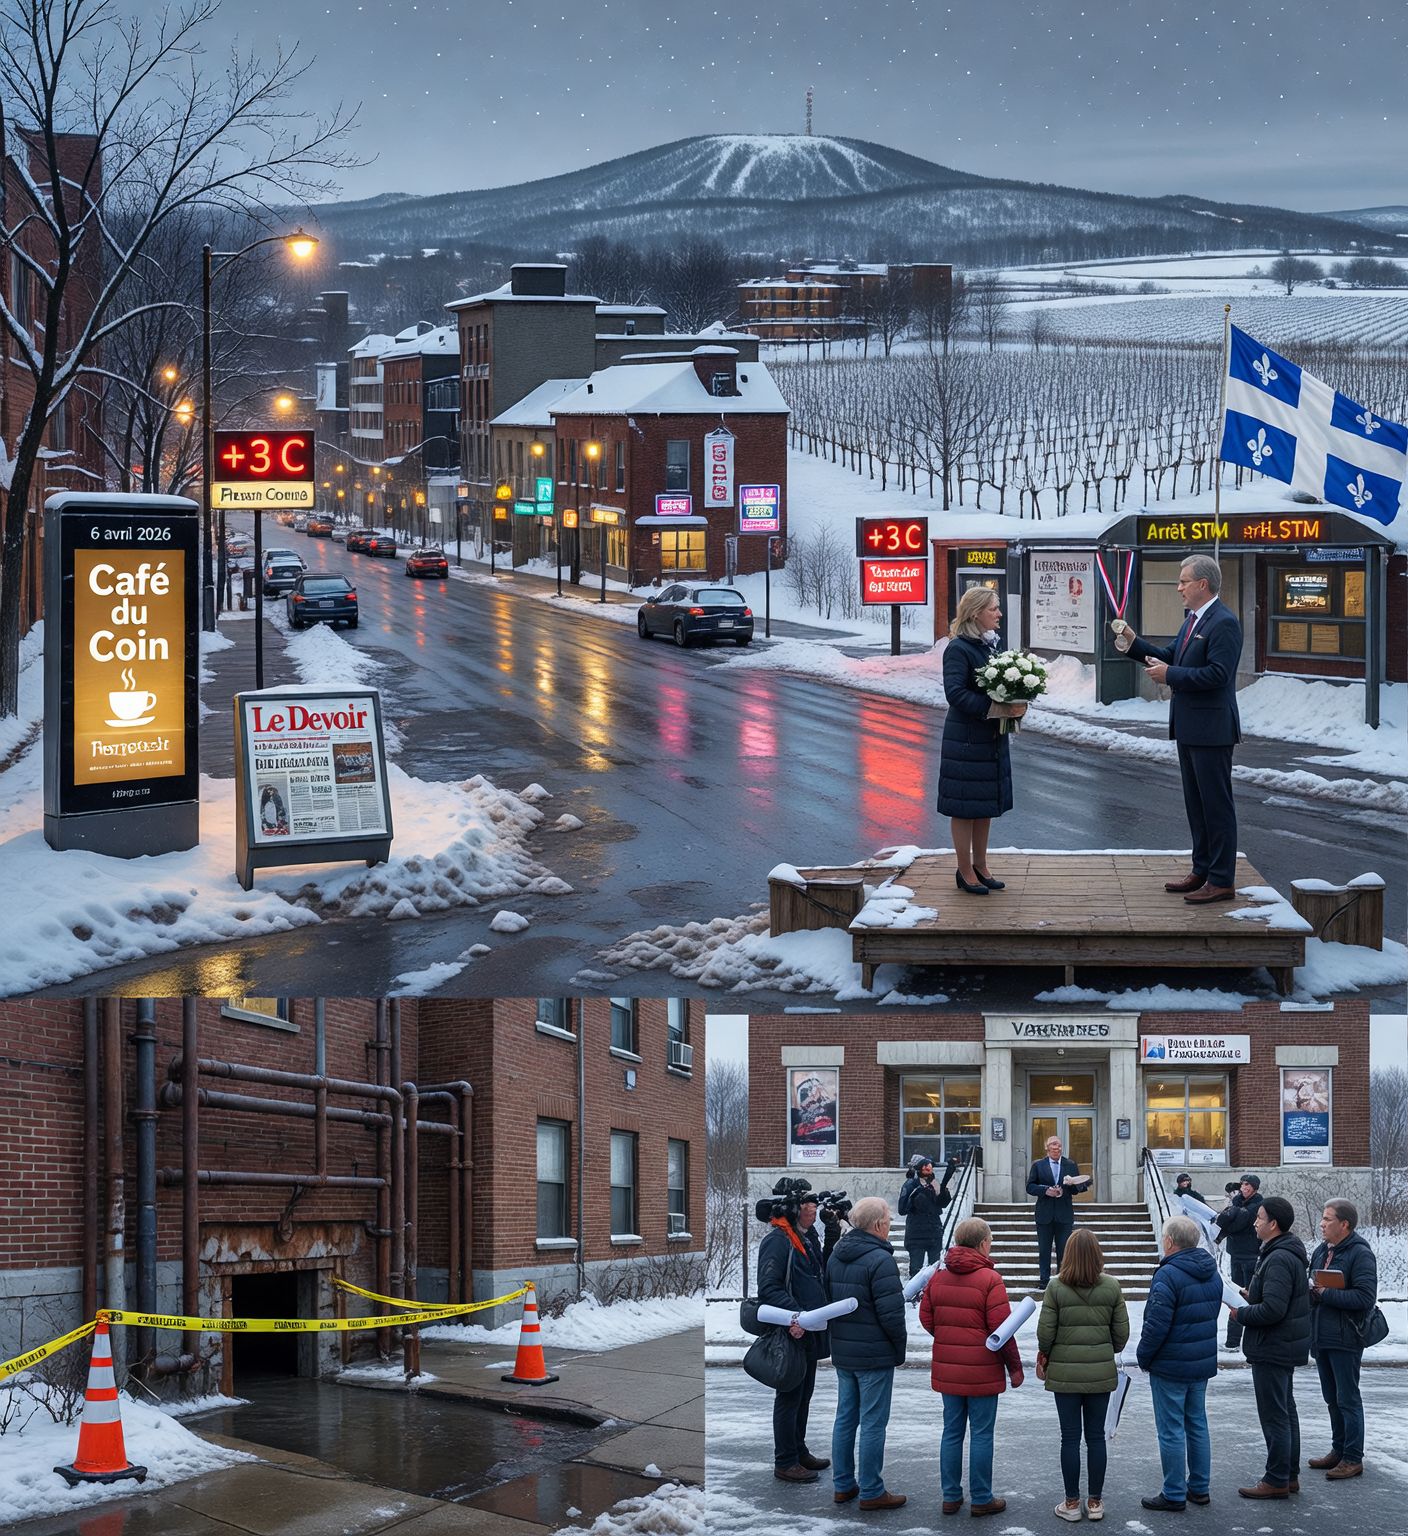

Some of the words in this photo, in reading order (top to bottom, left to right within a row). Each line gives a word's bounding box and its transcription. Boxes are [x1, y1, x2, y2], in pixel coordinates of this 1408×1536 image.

[90, 526, 100, 540] 6
[104, 526, 132, 540] avril
[137, 527, 171, 541] 2026
[1191, 522, 1228, 540] STM
[88, 562, 170, 596] Café
[111, 598, 147, 625] du
[89, 629, 169, 662] Coin
[251, 706, 285, 733] Le
[285, 703, 368, 732] Devoir
